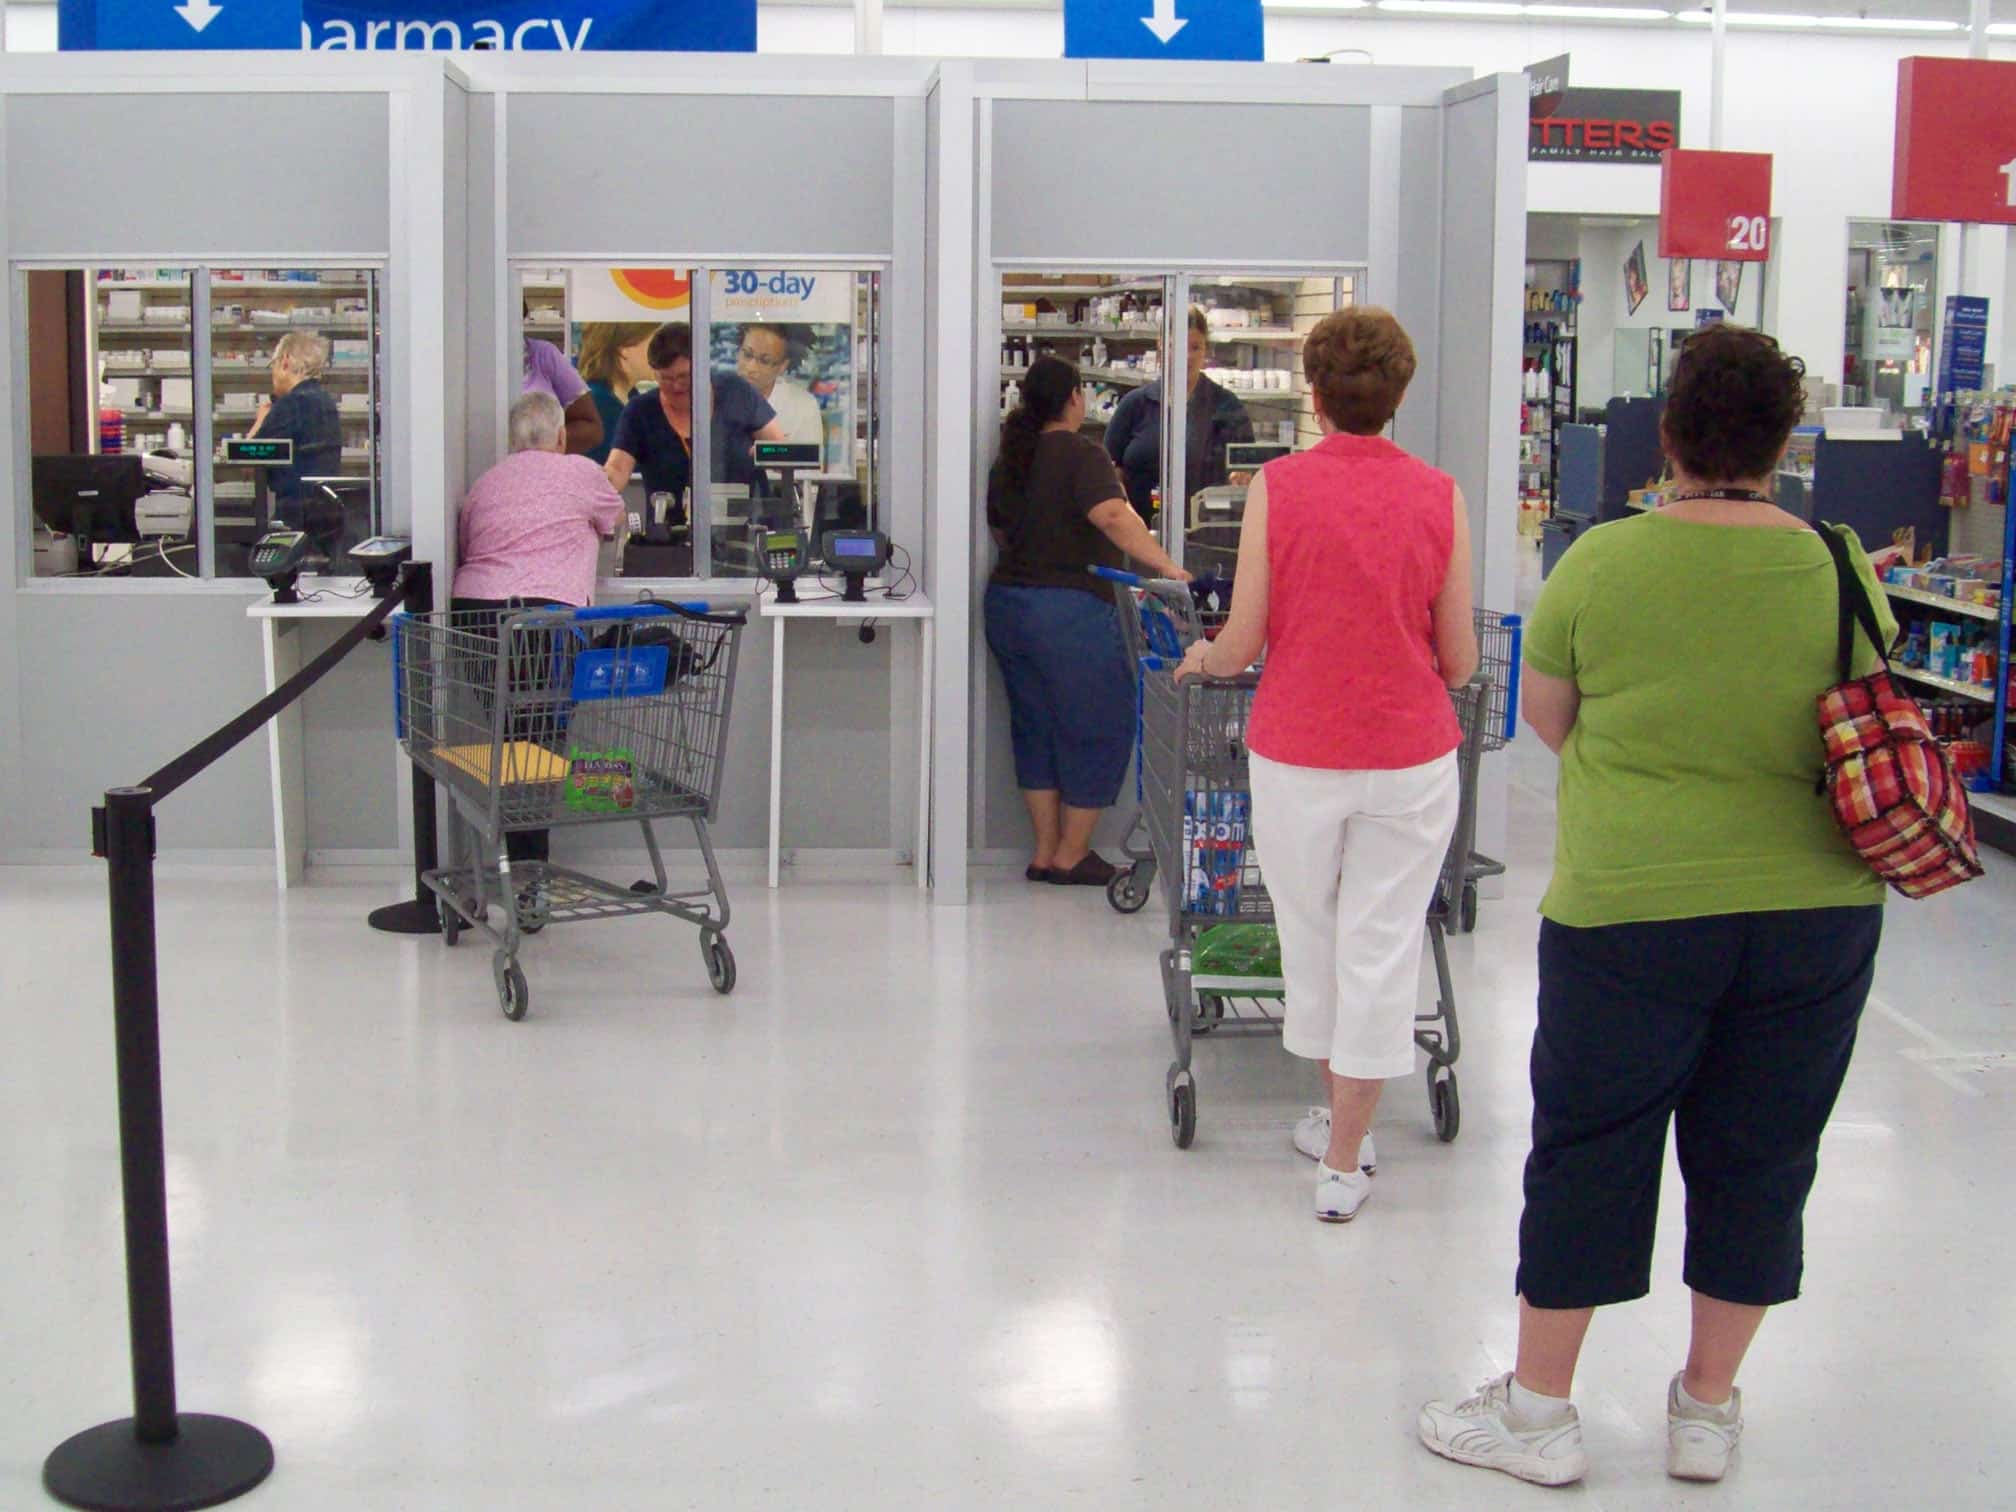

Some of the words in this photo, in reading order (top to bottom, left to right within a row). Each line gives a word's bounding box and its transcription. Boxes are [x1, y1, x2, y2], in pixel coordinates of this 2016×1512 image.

[1531, 147, 1581, 155] FAMILY
[1589, 149, 1623, 157] HAIR
[1729, 215, 1766, 250] 20
[724, 270, 815, 300] 30-day
